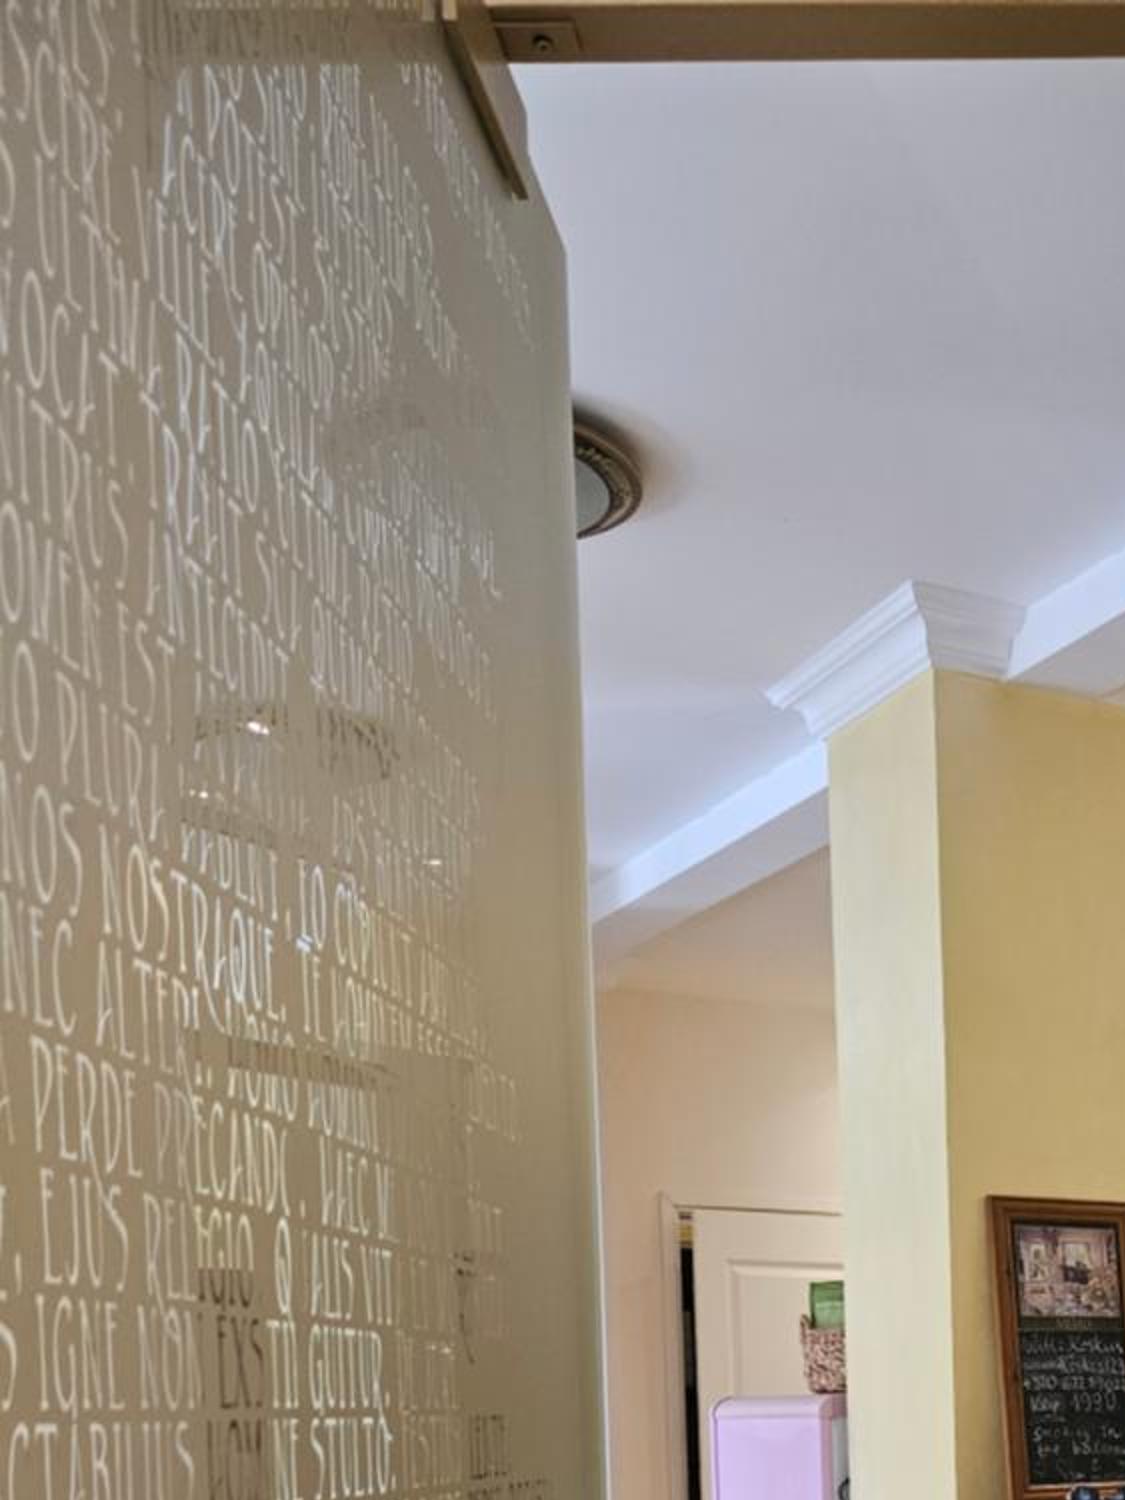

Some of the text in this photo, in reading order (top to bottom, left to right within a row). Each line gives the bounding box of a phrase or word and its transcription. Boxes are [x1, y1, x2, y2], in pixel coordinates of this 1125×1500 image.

[116, 596, 176, 750] EST
[30, 1033, 143, 1182] PERDE
[40, 1165, 128, 1294] EJUS
[35, 1292, 125, 1414] IGNE
